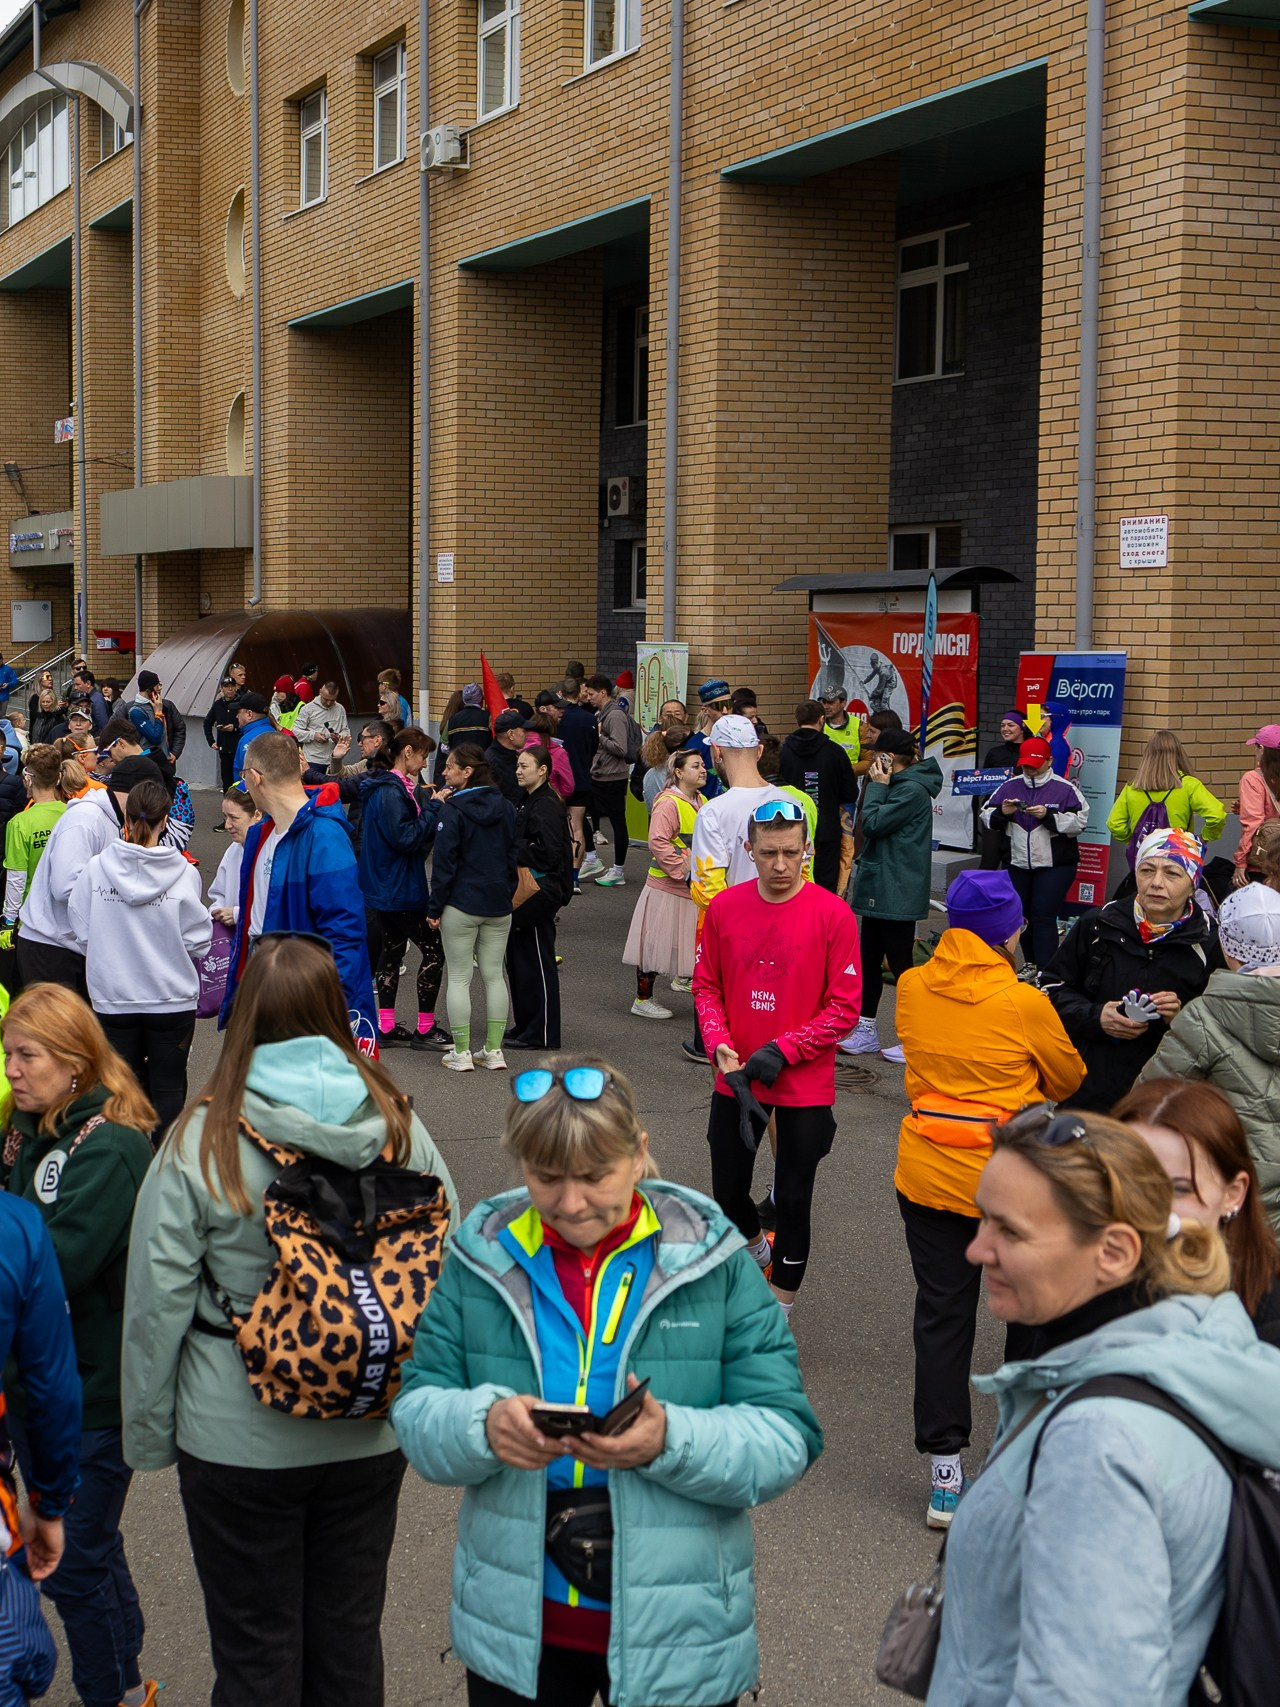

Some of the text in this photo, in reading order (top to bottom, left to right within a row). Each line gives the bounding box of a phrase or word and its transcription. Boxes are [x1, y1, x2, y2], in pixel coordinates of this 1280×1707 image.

[1121, 517, 1166, 526] ВНИМАНИЕ
[1123, 526, 1164, 535] автомобили
[1130, 534, 1166, 542] парковать,
[1134, 558, 1157, 566] крыши
[892, 632, 970, 658] ГОРДМСЯ!
[751, 990, 776, 1001] NENA
[751, 1001, 776, 1012] EBNIS
[346, 1268, 391, 1418] UNDER BY ME
